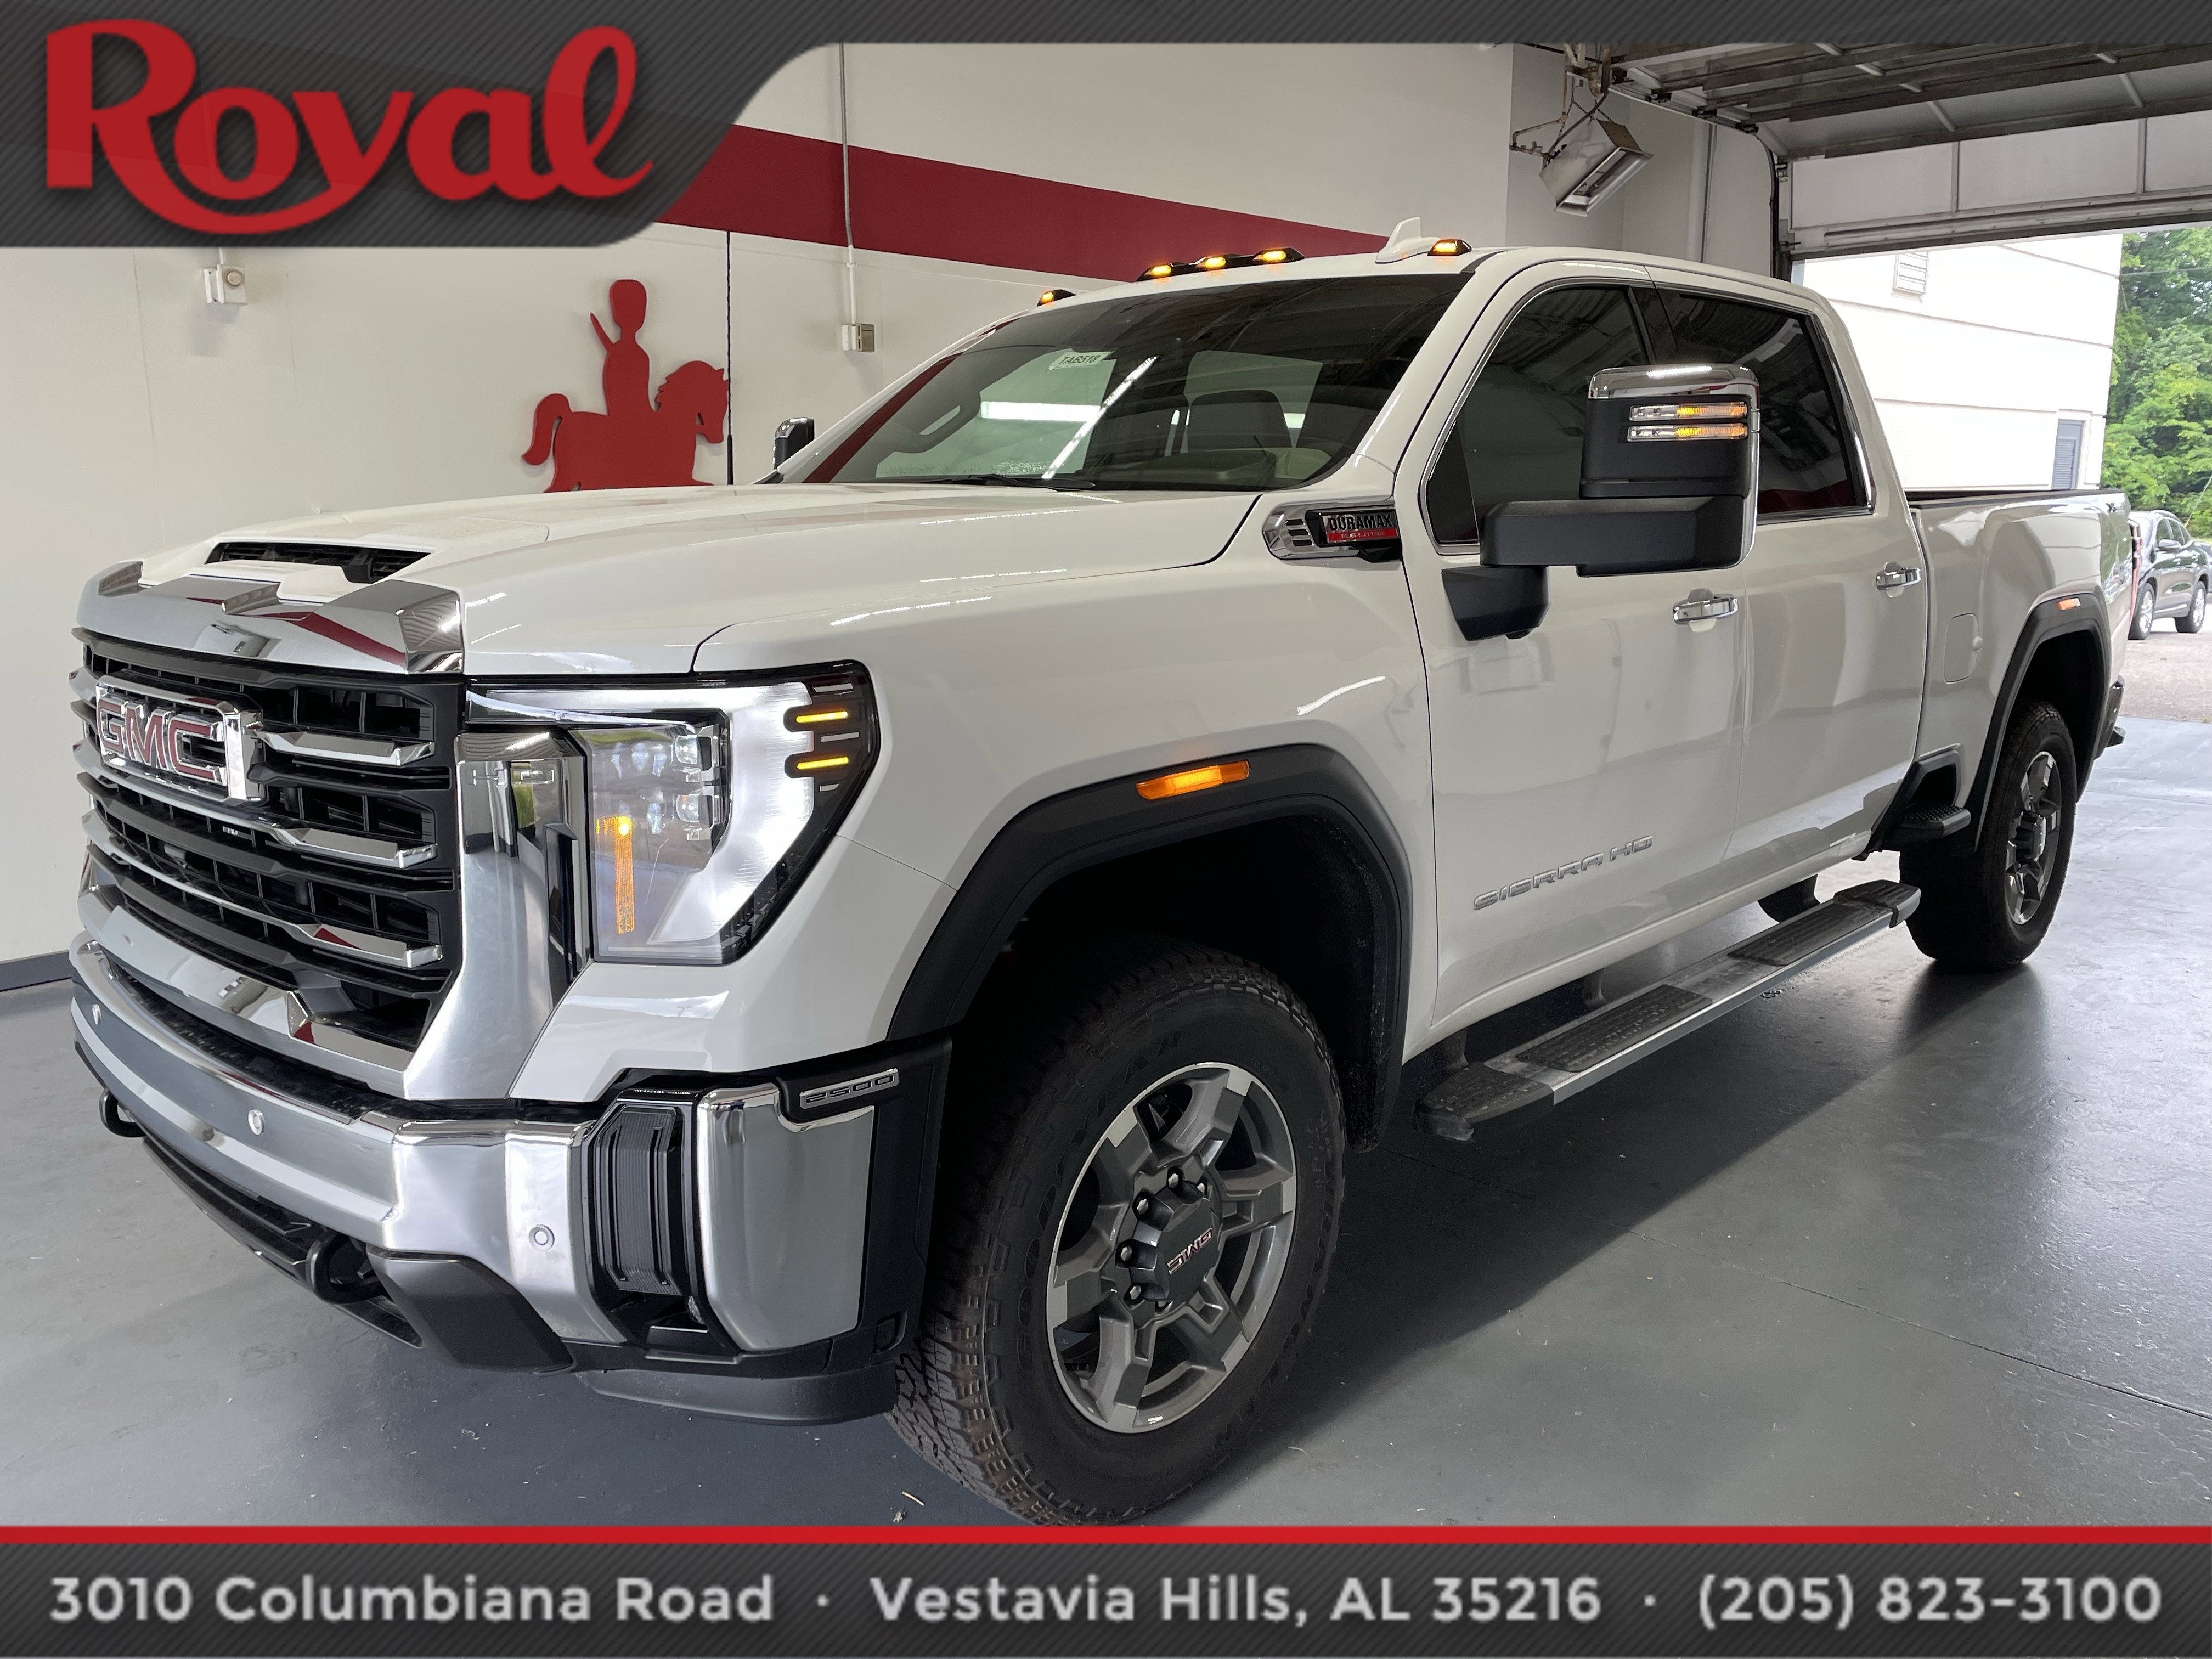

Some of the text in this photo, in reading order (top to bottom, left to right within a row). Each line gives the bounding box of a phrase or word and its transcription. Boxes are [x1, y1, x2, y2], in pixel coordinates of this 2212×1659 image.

[1330, 515, 1393, 531] DURAMAX
[95, 693, 227, 786] GMC
[1473, 834, 1654, 910] SIERRA HD
[806, 1075, 894, 1104] 2500
[1167, 1227, 1214, 1275] GMC
